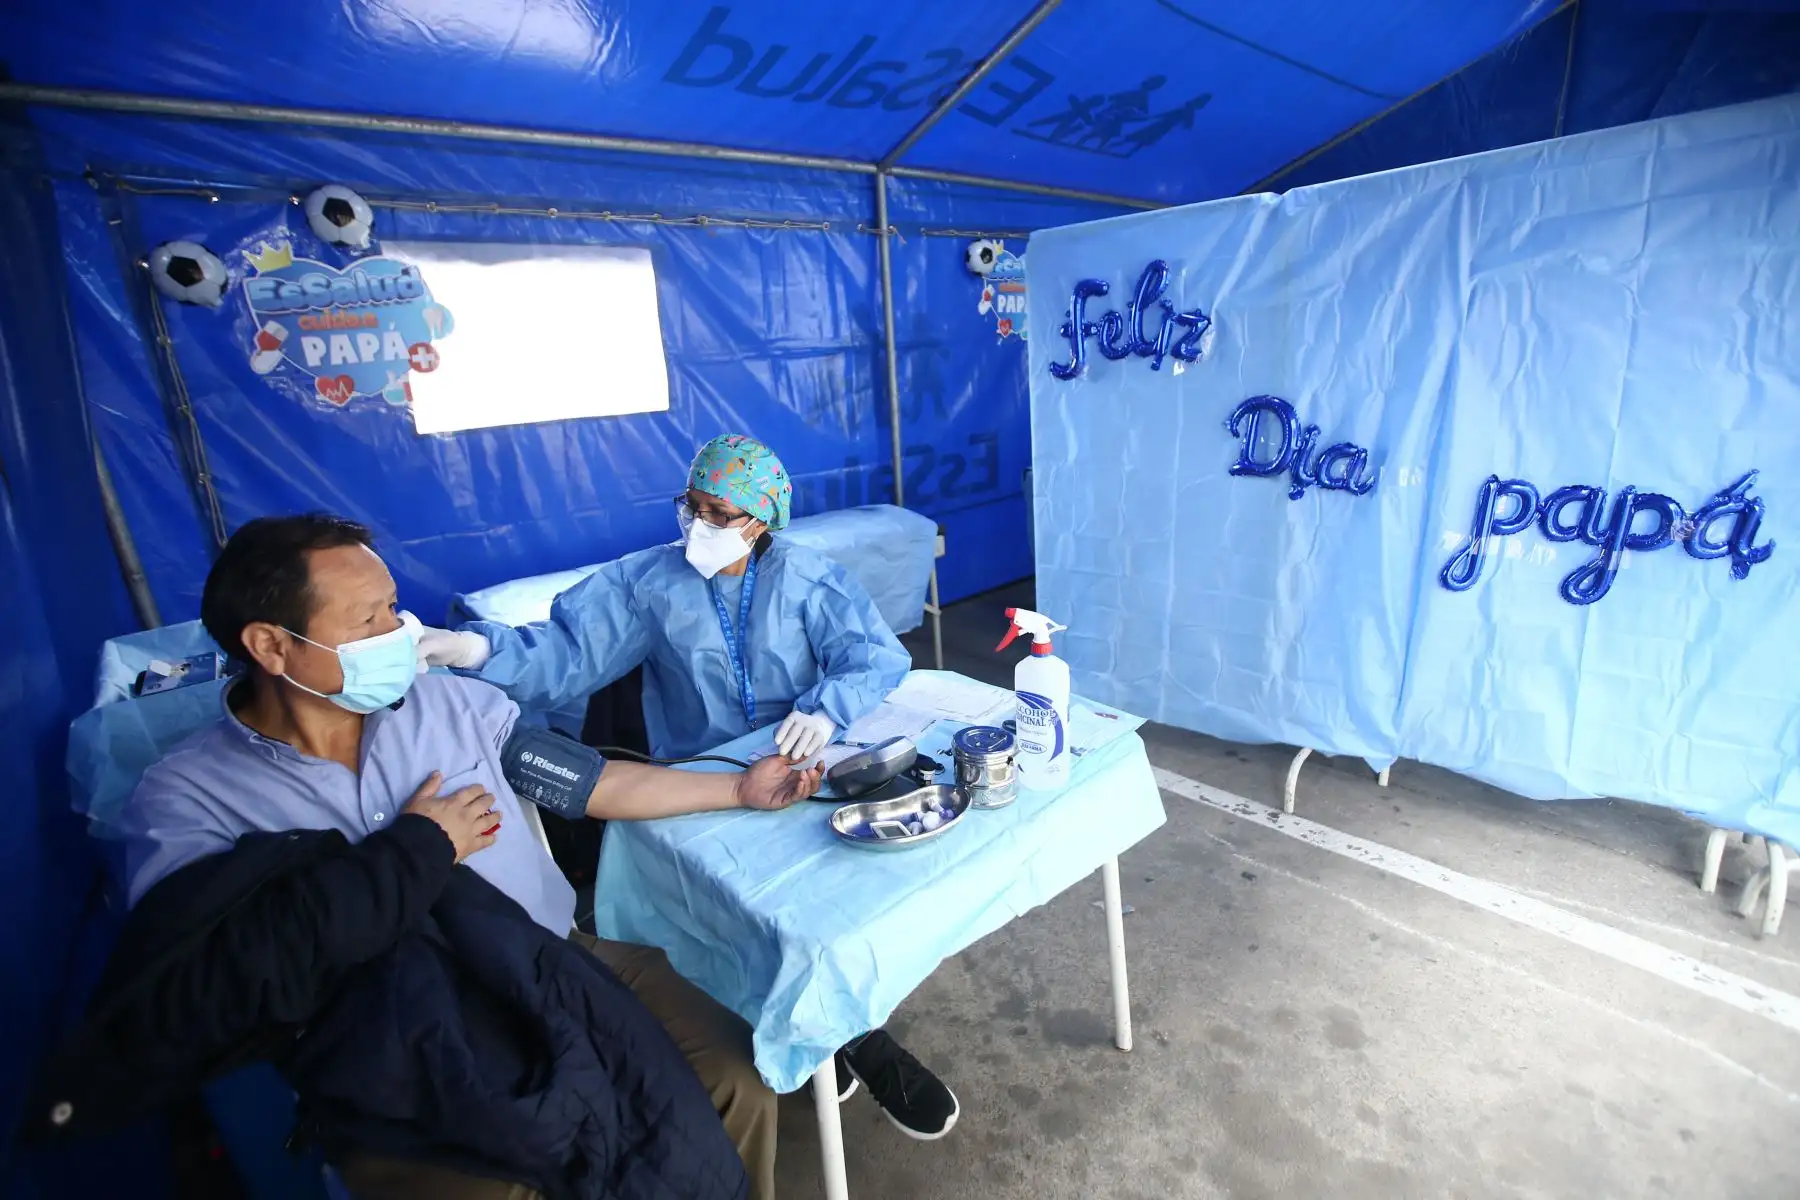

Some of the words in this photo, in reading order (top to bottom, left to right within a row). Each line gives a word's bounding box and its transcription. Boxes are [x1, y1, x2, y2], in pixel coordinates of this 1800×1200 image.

[249, 266, 424, 308] EsSalud
[997, 294, 1028, 313] PAP
[301, 321, 410, 367] PAPÁ
[1440, 469, 1776, 606] papá
[532, 755, 581, 781] Riester
